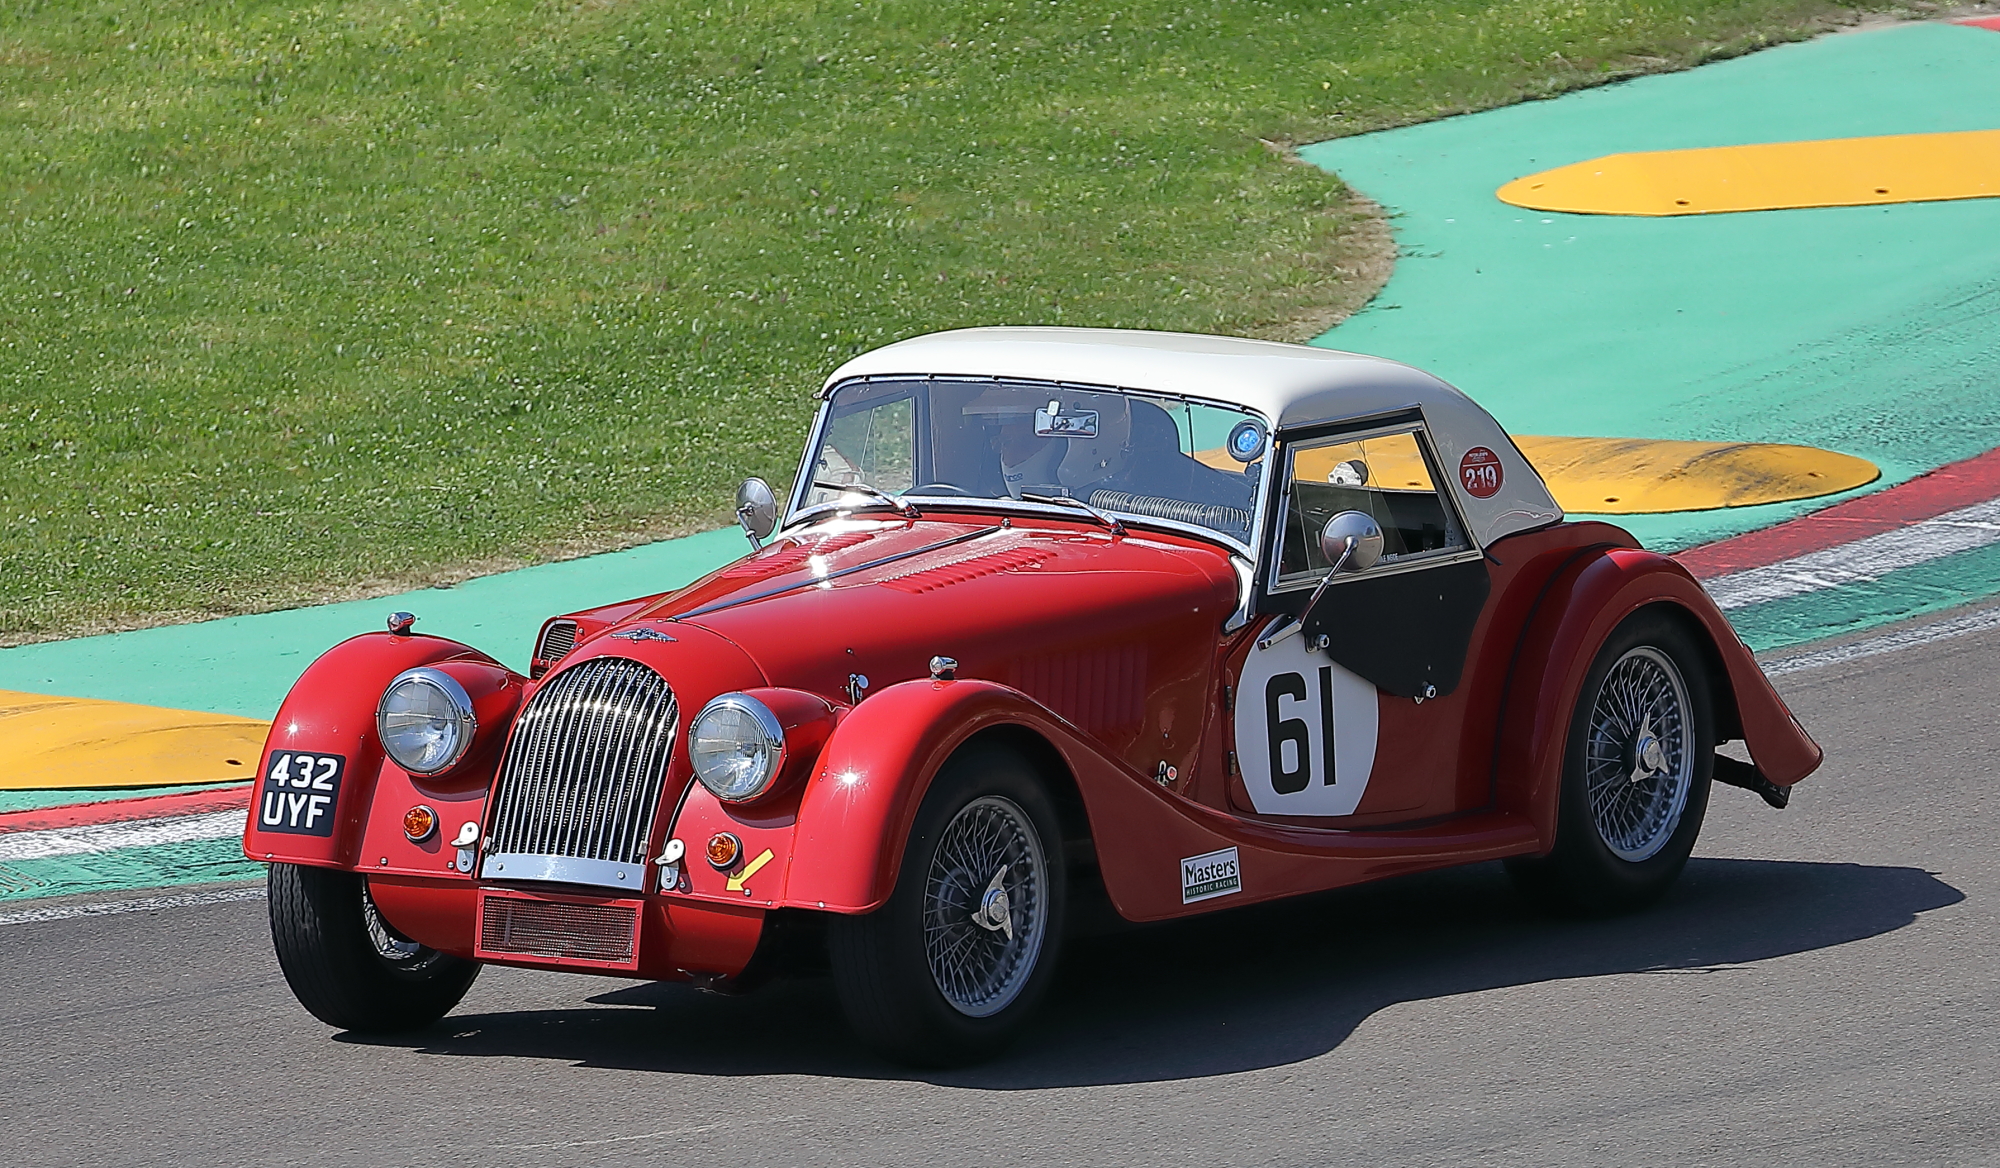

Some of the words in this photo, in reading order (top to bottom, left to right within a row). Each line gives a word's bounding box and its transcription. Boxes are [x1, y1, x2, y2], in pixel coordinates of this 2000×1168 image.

[1465, 465, 1497, 490] 219
[1265, 665, 1337, 795] 61
[270, 754, 338, 791] 432
[263, 791, 331, 828] UYF
[1185, 860, 1236, 886] Masters
[1186, 883, 1213, 896] HISTORIC
[1215, 877, 1237, 889] RACING
